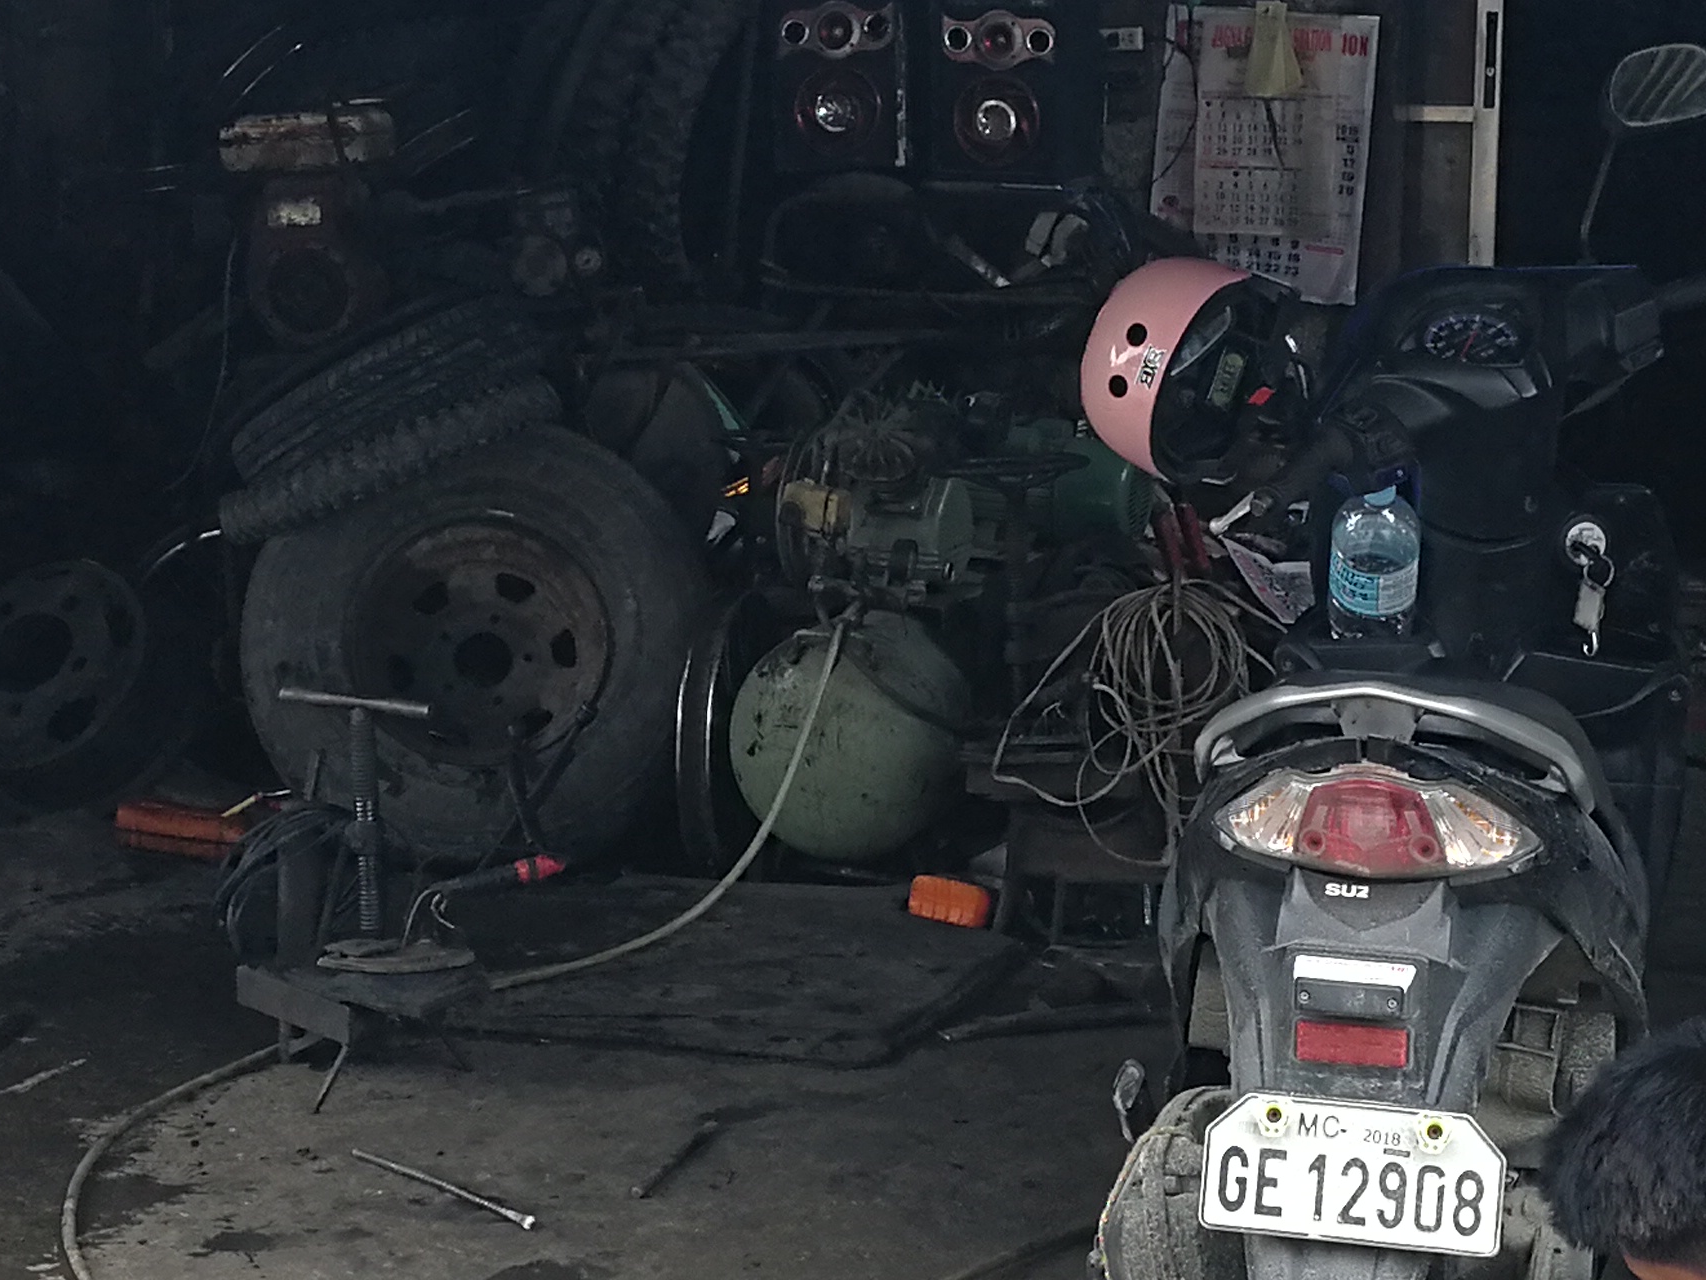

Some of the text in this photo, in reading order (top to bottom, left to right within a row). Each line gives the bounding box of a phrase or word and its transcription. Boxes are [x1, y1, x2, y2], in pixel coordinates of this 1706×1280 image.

[1325, 883, 1369, 899] SUZ
[1363, 1129, 1401, 1146] 2018
[1218, 1146, 1484, 1237] GE 12908
